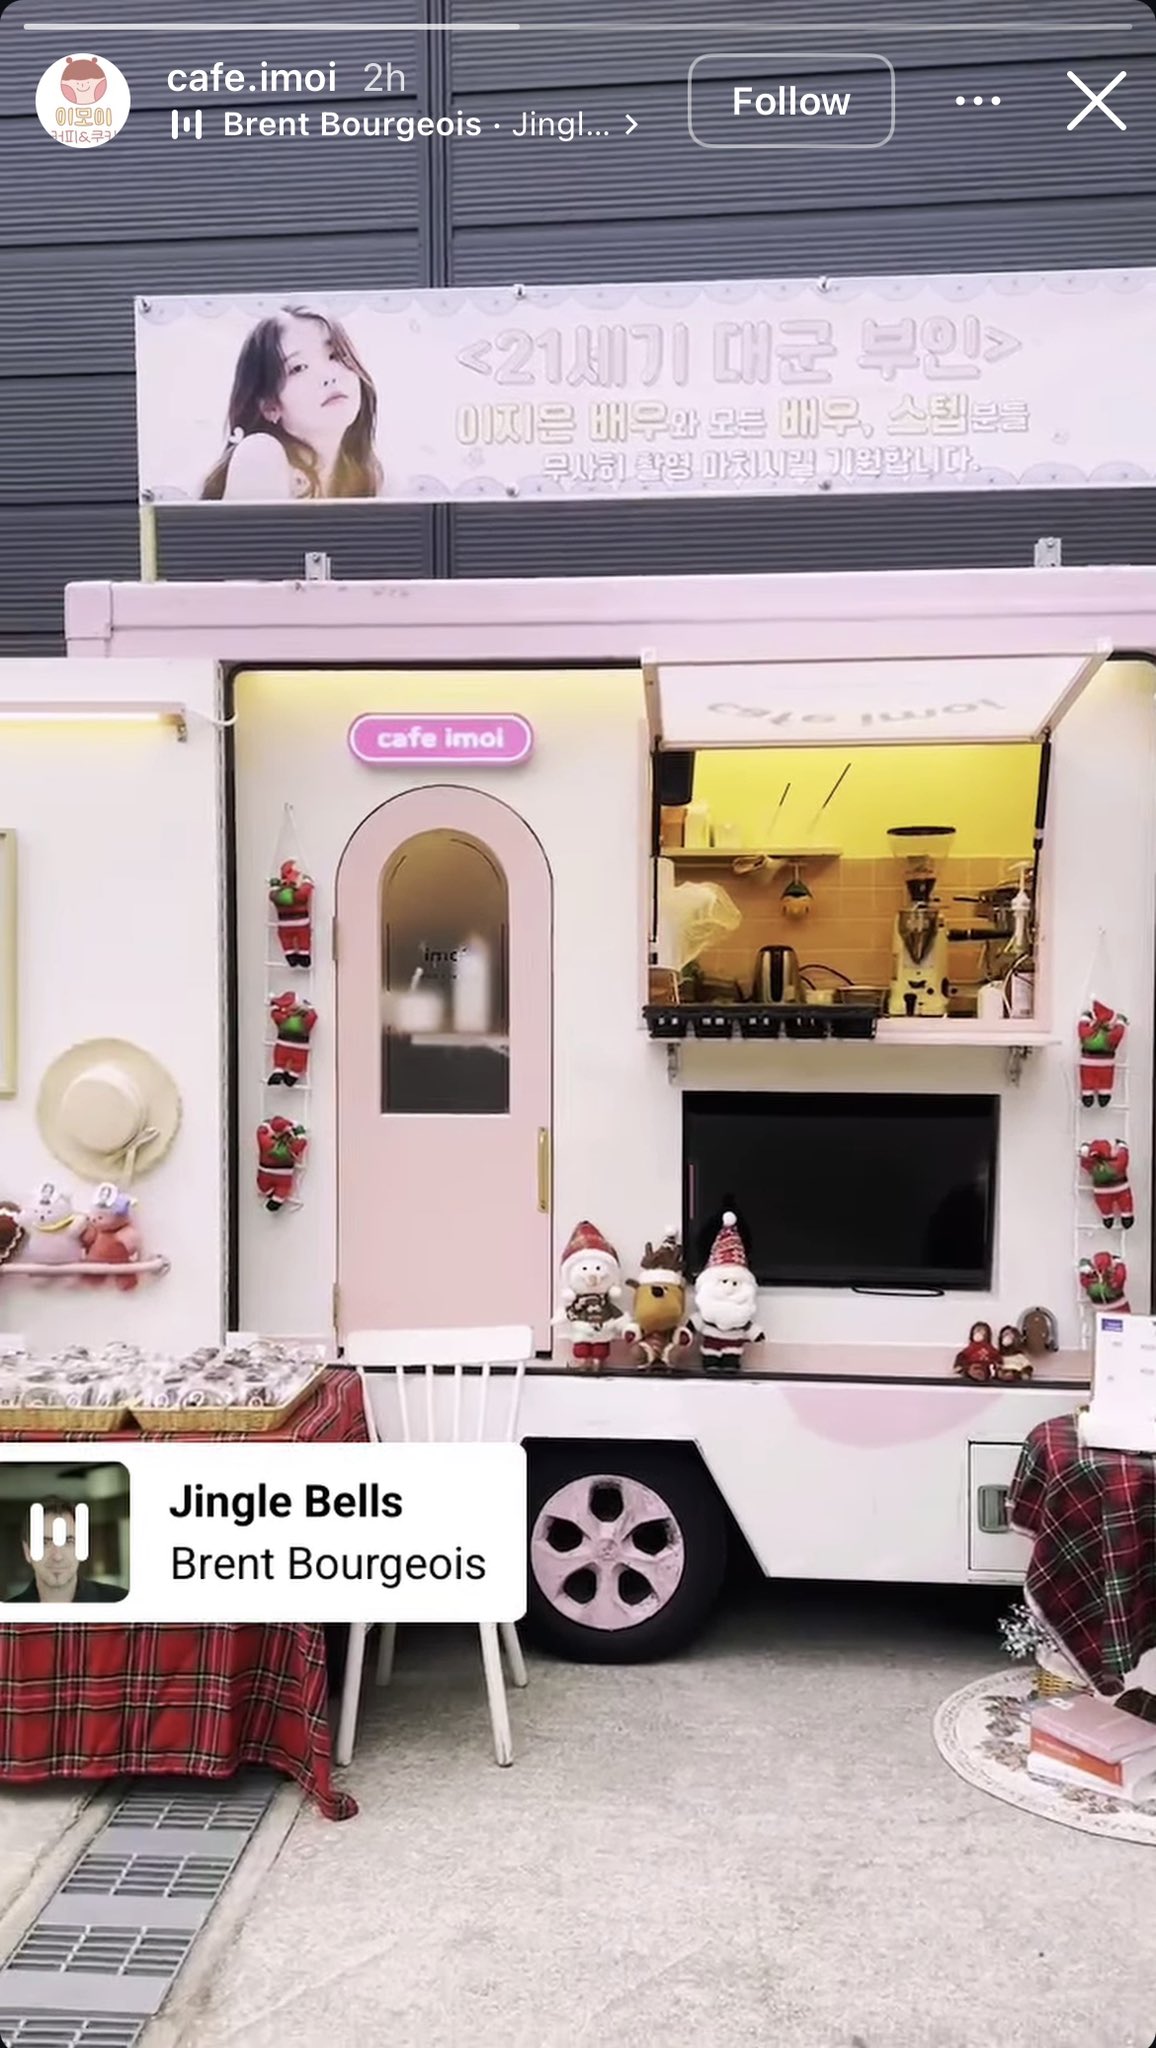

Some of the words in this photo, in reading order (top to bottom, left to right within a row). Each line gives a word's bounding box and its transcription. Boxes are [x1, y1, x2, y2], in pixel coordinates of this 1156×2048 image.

[456, 321, 690, 389] <21세기
[712, 318, 838, 386] 대군
[856, 314, 1023, 382] 부인>
[455, 402, 576, 445] 이지은
[588, 399, 701, 442] 배우와
[709, 406, 768, 439] 모든
[778, 396, 874, 439] 배우,
[543, 451, 627, 482] 무사히
[635, 450, 693, 482] 촬영
[701, 447, 817, 480] 마치시길
[826, 445, 982, 478] 기원합니다.
[376, 725, 438, 749] cafe
[444, 726, 505, 749] imoi
